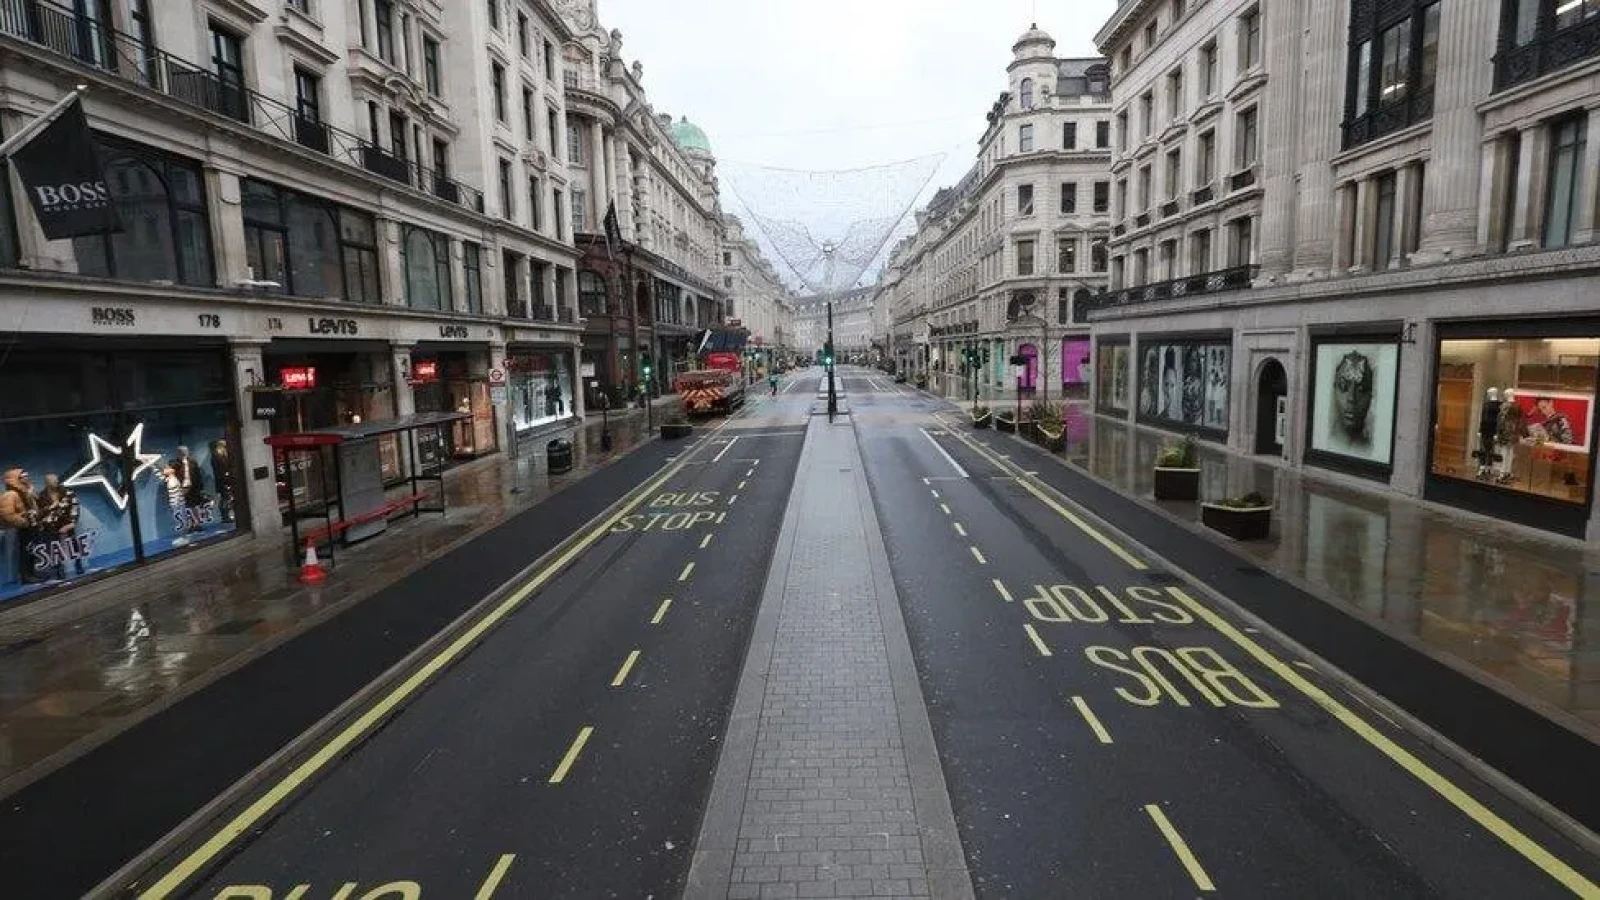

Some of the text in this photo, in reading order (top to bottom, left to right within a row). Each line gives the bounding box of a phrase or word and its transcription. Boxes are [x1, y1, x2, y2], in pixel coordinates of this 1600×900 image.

[34, 181, 107, 206] BOSS
[92, 307, 136, 322] BOSS
[198, 314, 221, 328] 178
[649, 491, 720, 507] BUS
[611, 511, 716, 532] STOP
[1023, 584, 1195, 624] STOP
[1084, 645, 1281, 709] BUS
